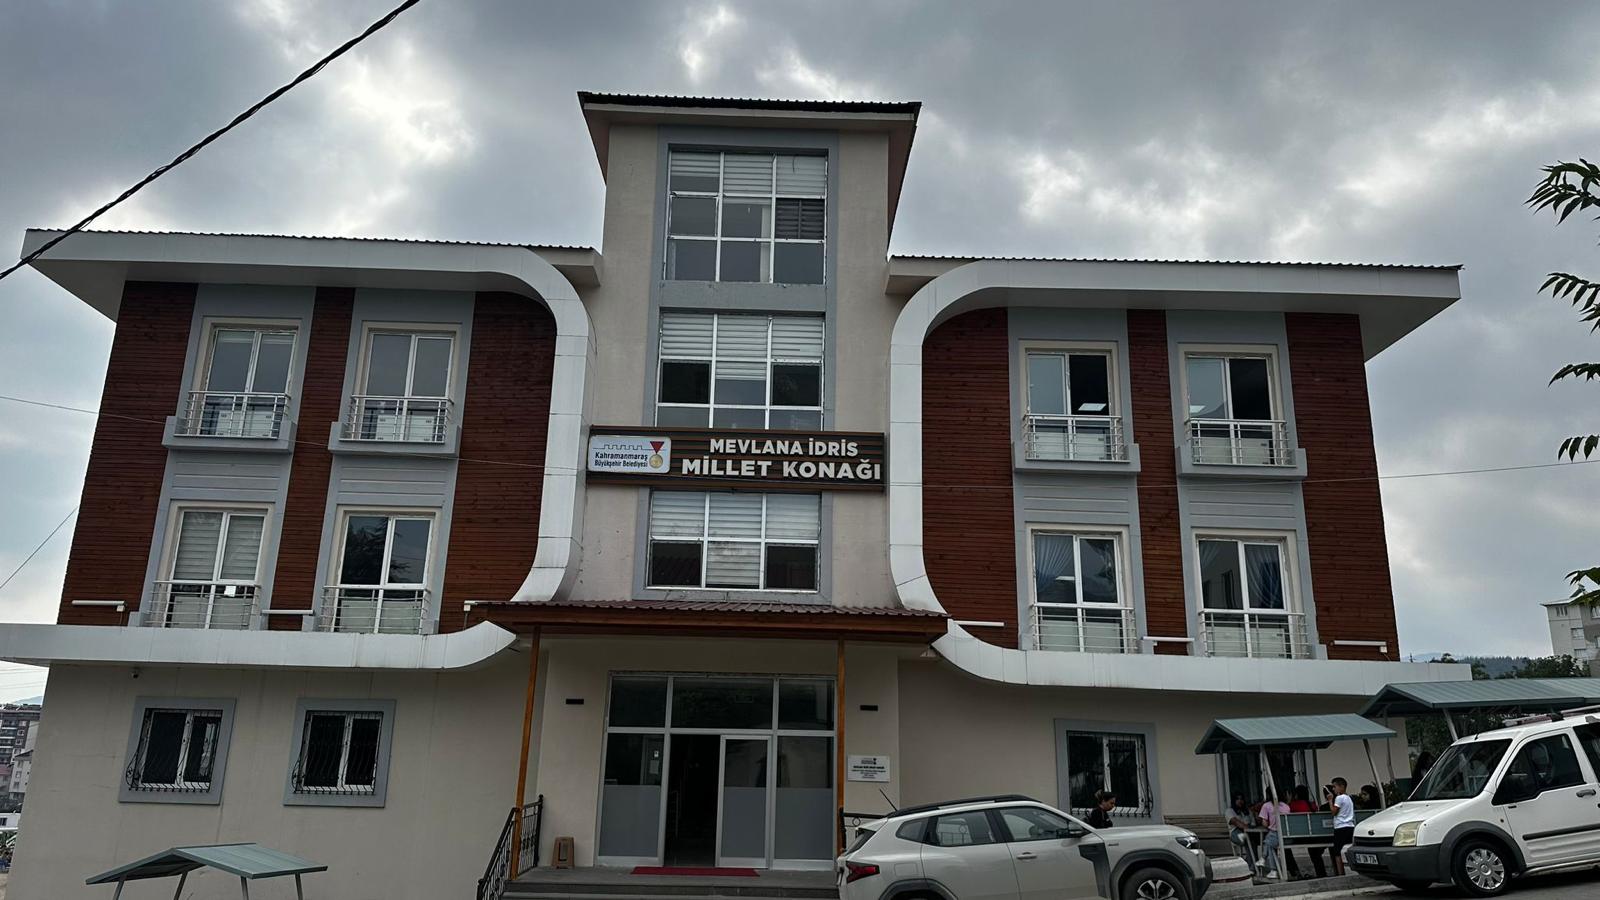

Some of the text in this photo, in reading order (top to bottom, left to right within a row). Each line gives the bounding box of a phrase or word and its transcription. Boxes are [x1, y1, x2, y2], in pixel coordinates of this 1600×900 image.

[709, 437, 859, 457] MEVLANA İDRİS
[594, 451, 648, 461] Kahramanmaraş
[594, 459, 648, 469] Büyükşehir Belediyesi
[681, 456, 881, 480] MİLLET KONAĞI
